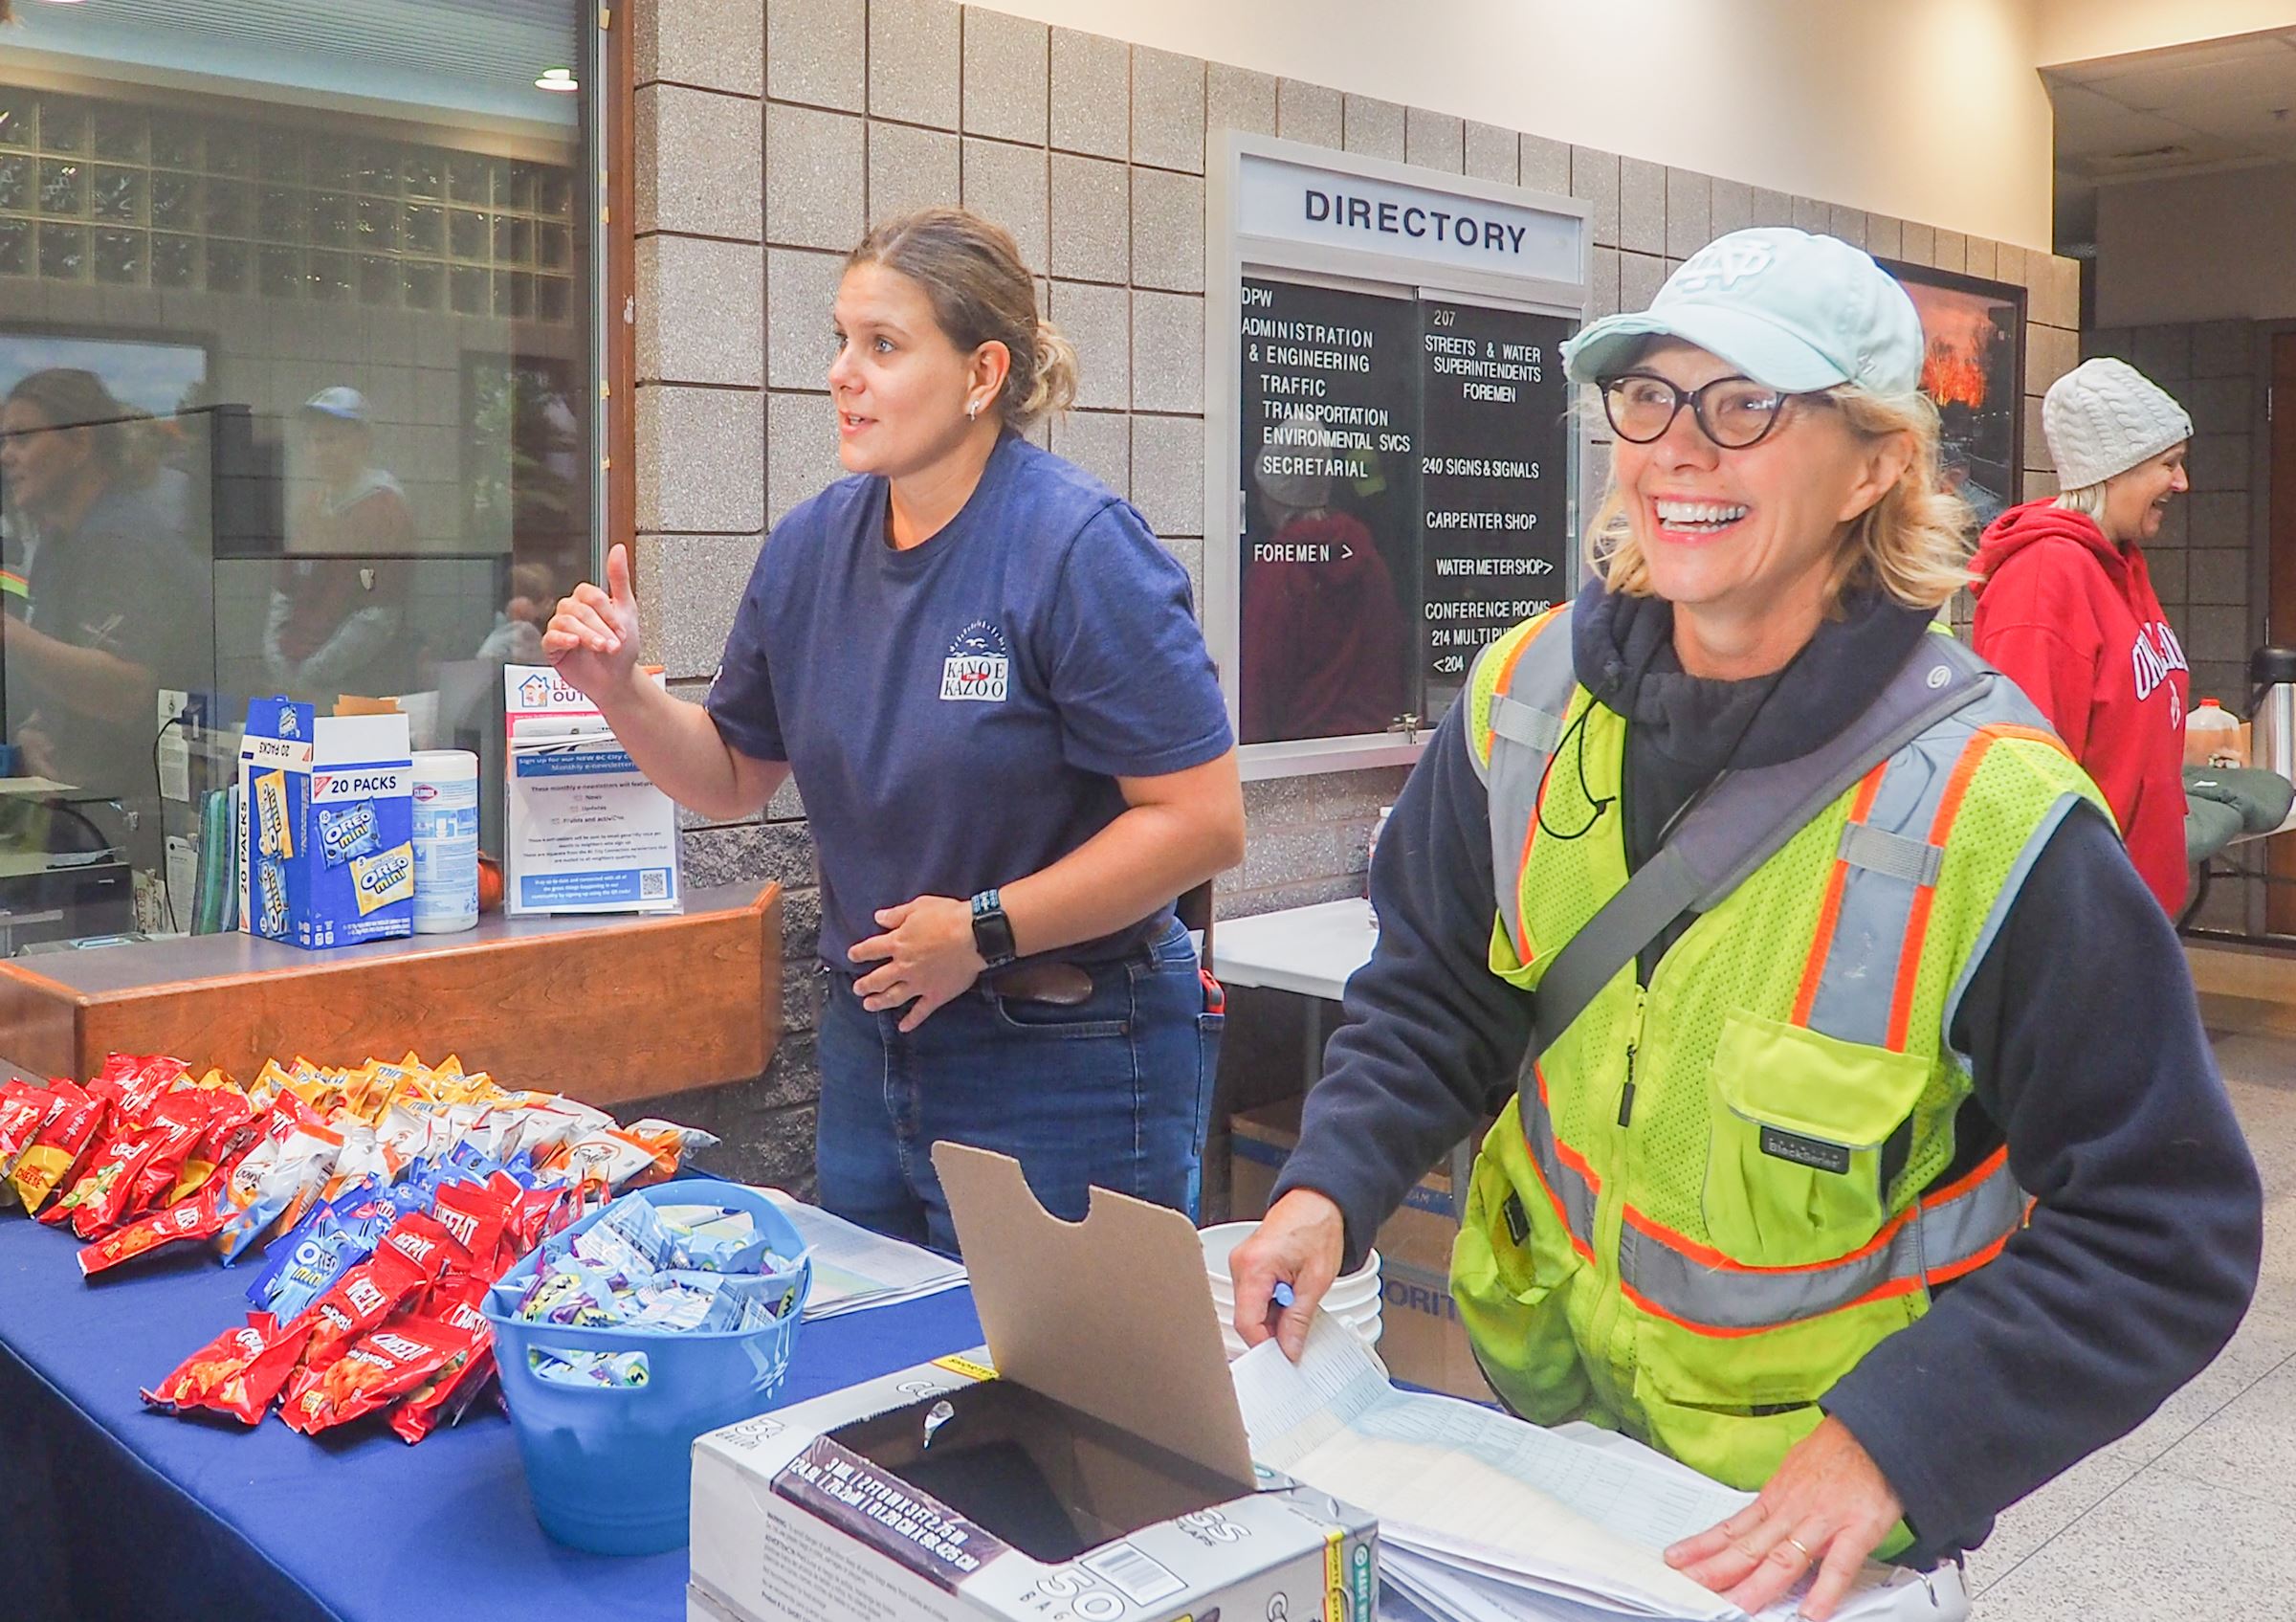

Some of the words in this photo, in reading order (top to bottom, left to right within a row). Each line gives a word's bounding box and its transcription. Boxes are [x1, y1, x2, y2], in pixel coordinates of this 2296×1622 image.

[1305, 189, 1527, 254] DIRECTORY
[1242, 287, 1272, 307] DPW
[1434, 310, 1456, 326] 207
[1242, 318, 1373, 348] ADMINISTRATION
[1249, 344, 1259, 362] &
[1267, 345, 1370, 372] ENGINEERING
[1424, 335, 1476, 356] STREETS
[1487, 342, 1494, 358] &
[1503, 344, 1541, 363] WATER
[1434, 357, 1541, 383] SUPERINTENDENTS
[1260, 374, 1326, 397] TRAFFIC
[1463, 383, 1516, 403] FOREMEN
[1262, 401, 1388, 427] TRANSPORTATION
[1263, 427, 1374, 450] ENVIRONMENTAL
[1380, 433, 1411, 452] SVCS
[1263, 455, 1368, 478] SECRETARIAL
[1423, 457, 1443, 475] 240
[1426, 512, 1503, 529] CARPENTER
[1504, 514, 1537, 530] SHOP
[1254, 544, 1330, 563] FOREMEN
[1436, 558, 1474, 575] WATER
[1424, 601, 1510, 620] CONFERENCE
[1512, 600, 1551, 617] ROOMS
[1431, 629, 1451, 647] 214
[947, 660, 1005, 679] KANOE
[553, 691, 584, 701] OUT
[943, 679, 1004, 698] KAZOO
[258, 741, 279, 755] PACKS
[280, 744, 290, 757] 20
[331, 778, 349, 793] 20
[354, 775, 397, 792] PACKS
[324, 811, 371, 844] OREO
[339, 823, 368, 849] mini
[240, 871, 248, 895] 20
[361, 856, 408, 890] OREO
[374, 868, 406, 894] mini
[15, 1167, 43, 1189] CHEESE
[295, 1240, 338, 1273] OREO
[1036, 1568, 1125, 1622] 50
